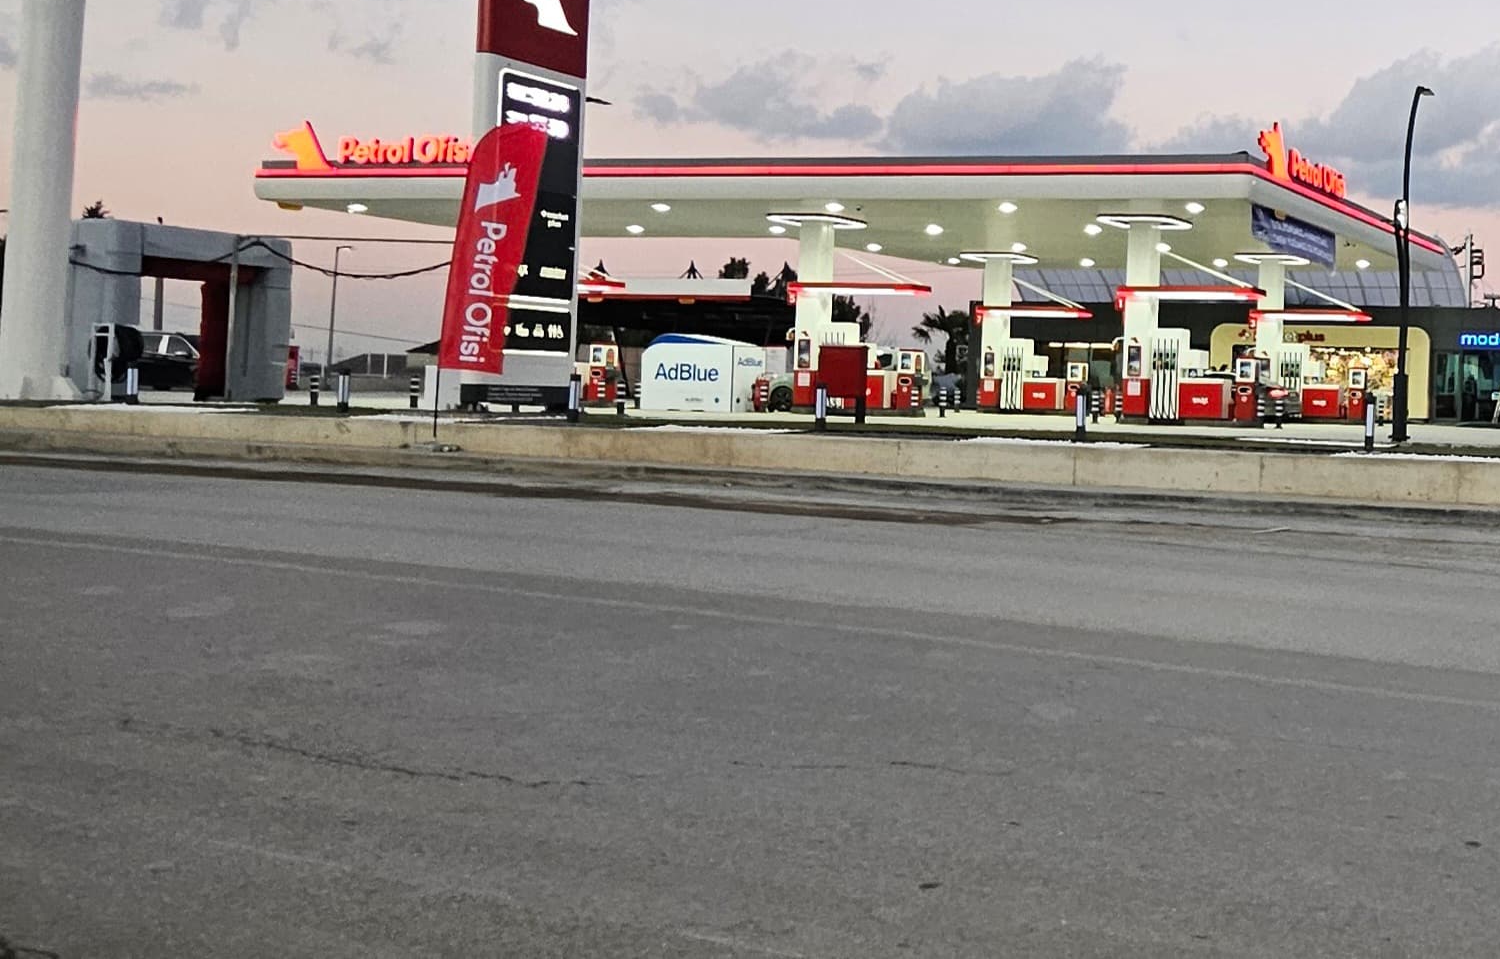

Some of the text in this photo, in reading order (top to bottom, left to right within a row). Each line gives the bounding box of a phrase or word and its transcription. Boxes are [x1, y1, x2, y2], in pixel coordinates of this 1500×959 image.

[338, 135, 414, 164] Petrol
[1288, 148, 1347, 199] Petrol Ofisi
[459, 221, 508, 363] Petrol Ofisi
[654, 362, 719, 382] AdBlue
